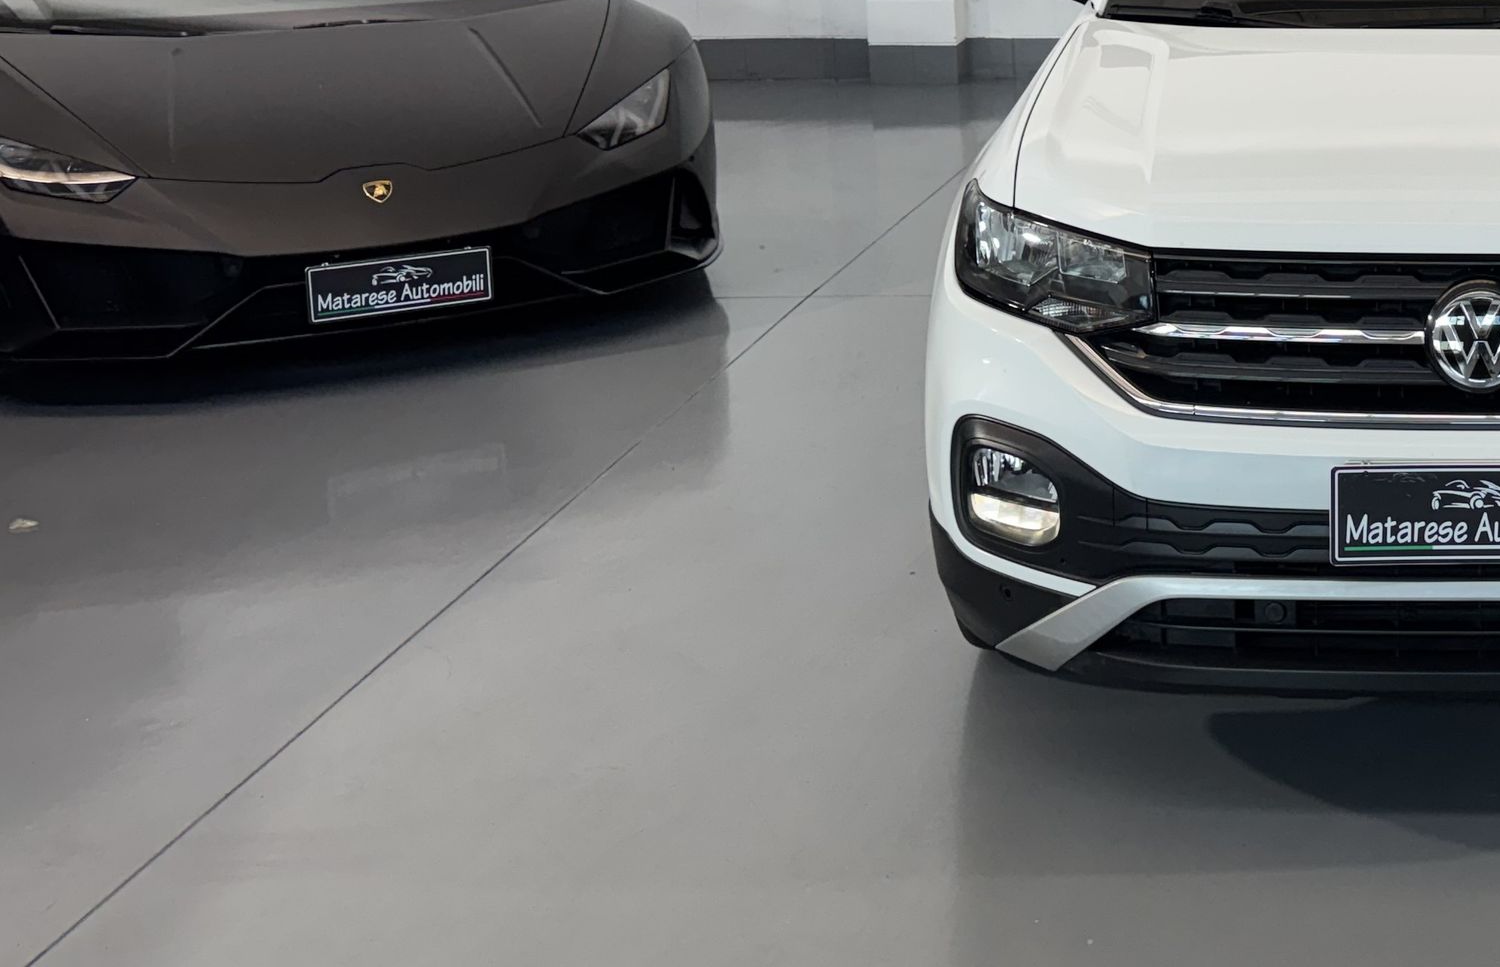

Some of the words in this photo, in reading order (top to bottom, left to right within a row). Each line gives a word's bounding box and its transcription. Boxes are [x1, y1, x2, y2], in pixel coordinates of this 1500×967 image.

[317, 290, 397, 311] Matarese
[400, 274, 484, 302] Automobili
[1345, 513, 1468, 543] Matarese
